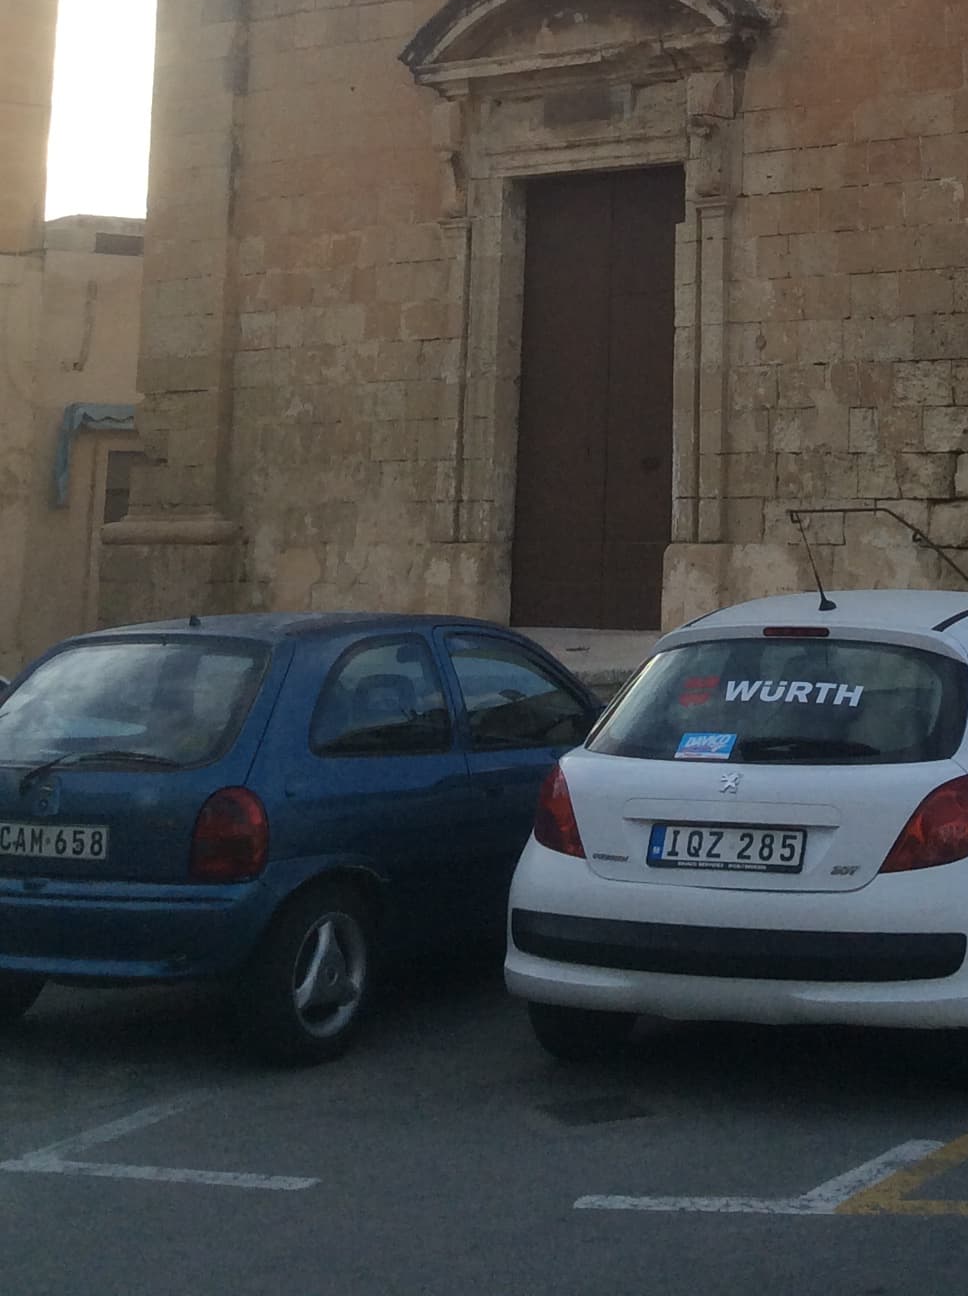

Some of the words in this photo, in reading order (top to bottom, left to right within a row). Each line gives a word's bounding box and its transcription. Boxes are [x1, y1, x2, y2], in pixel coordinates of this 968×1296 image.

[725, 680, 865, 708] WÜRTH
[667, 830, 724, 858] IQZ
[736, 833, 798, 866] 285
